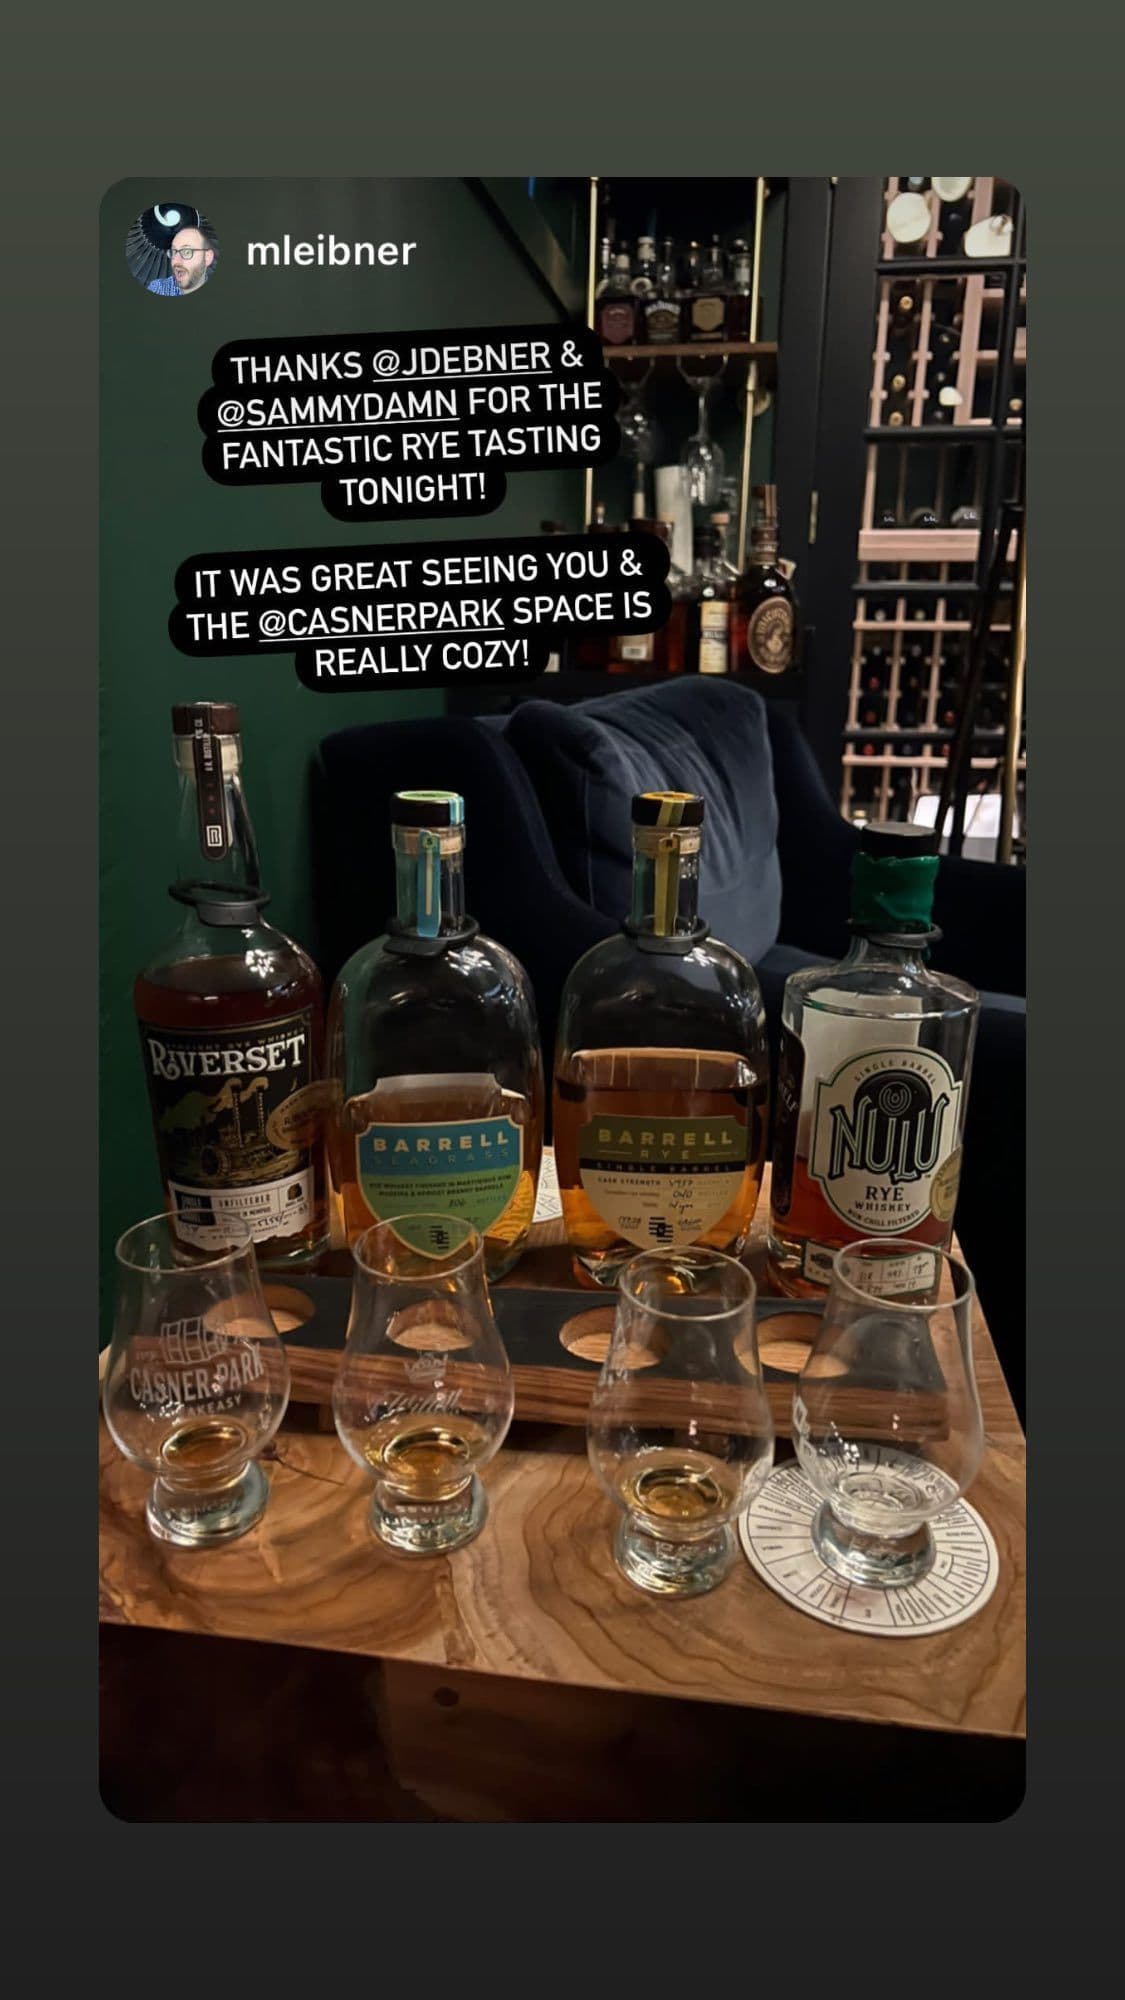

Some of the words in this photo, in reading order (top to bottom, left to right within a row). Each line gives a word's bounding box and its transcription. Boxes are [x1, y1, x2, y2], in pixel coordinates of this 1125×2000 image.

[147, 1034, 306, 1081] RIVERSET
[854, 1060, 894, 1082] SINGLE
[901, 1060, 937, 1085] BARREL
[373, 1130, 509, 1153] BARRELL
[597, 1128, 733, 1146] BARRELL
[828, 1092, 950, 1185] NULU
[639, 1149, 691, 1160] RYE
[865, 1185, 904, 1201] RYE
[854, 1201, 911, 1212] WHISKEY
[130, 1366, 212, 1404] CASNER
[216, 1341, 265, 1392] PARK
